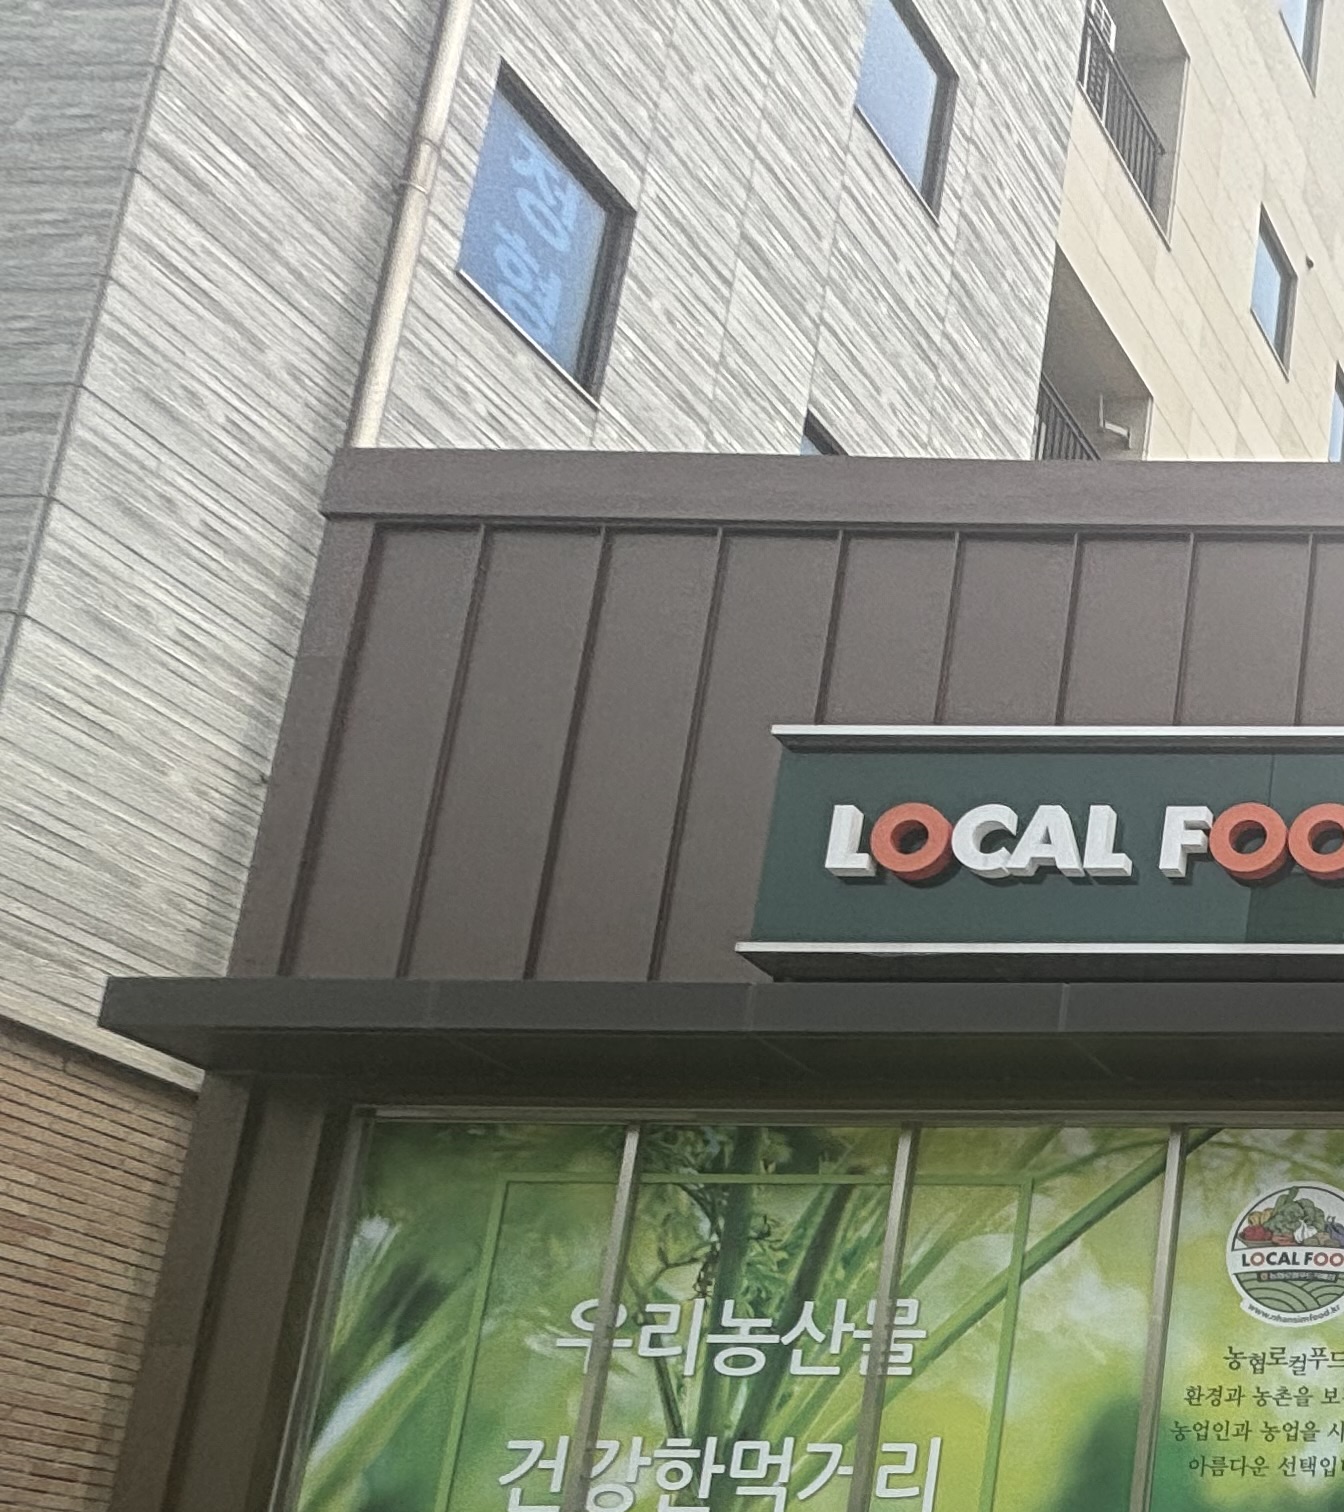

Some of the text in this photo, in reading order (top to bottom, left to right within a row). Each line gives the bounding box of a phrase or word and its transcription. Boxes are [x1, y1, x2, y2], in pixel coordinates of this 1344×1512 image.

[824, 801, 1133, 881] LOCAL
[1241, 1251, 1300, 1267] LOCAL
[1184, 1386, 1245, 1408] 환경과
[1252, 1386, 1313, 1408] 농촌을
[1170, 1421, 1252, 1443] 농업인과
[1260, 1421, 1321, 1443] 농업을
[1188, 1456, 1270, 1479] 아름다운
